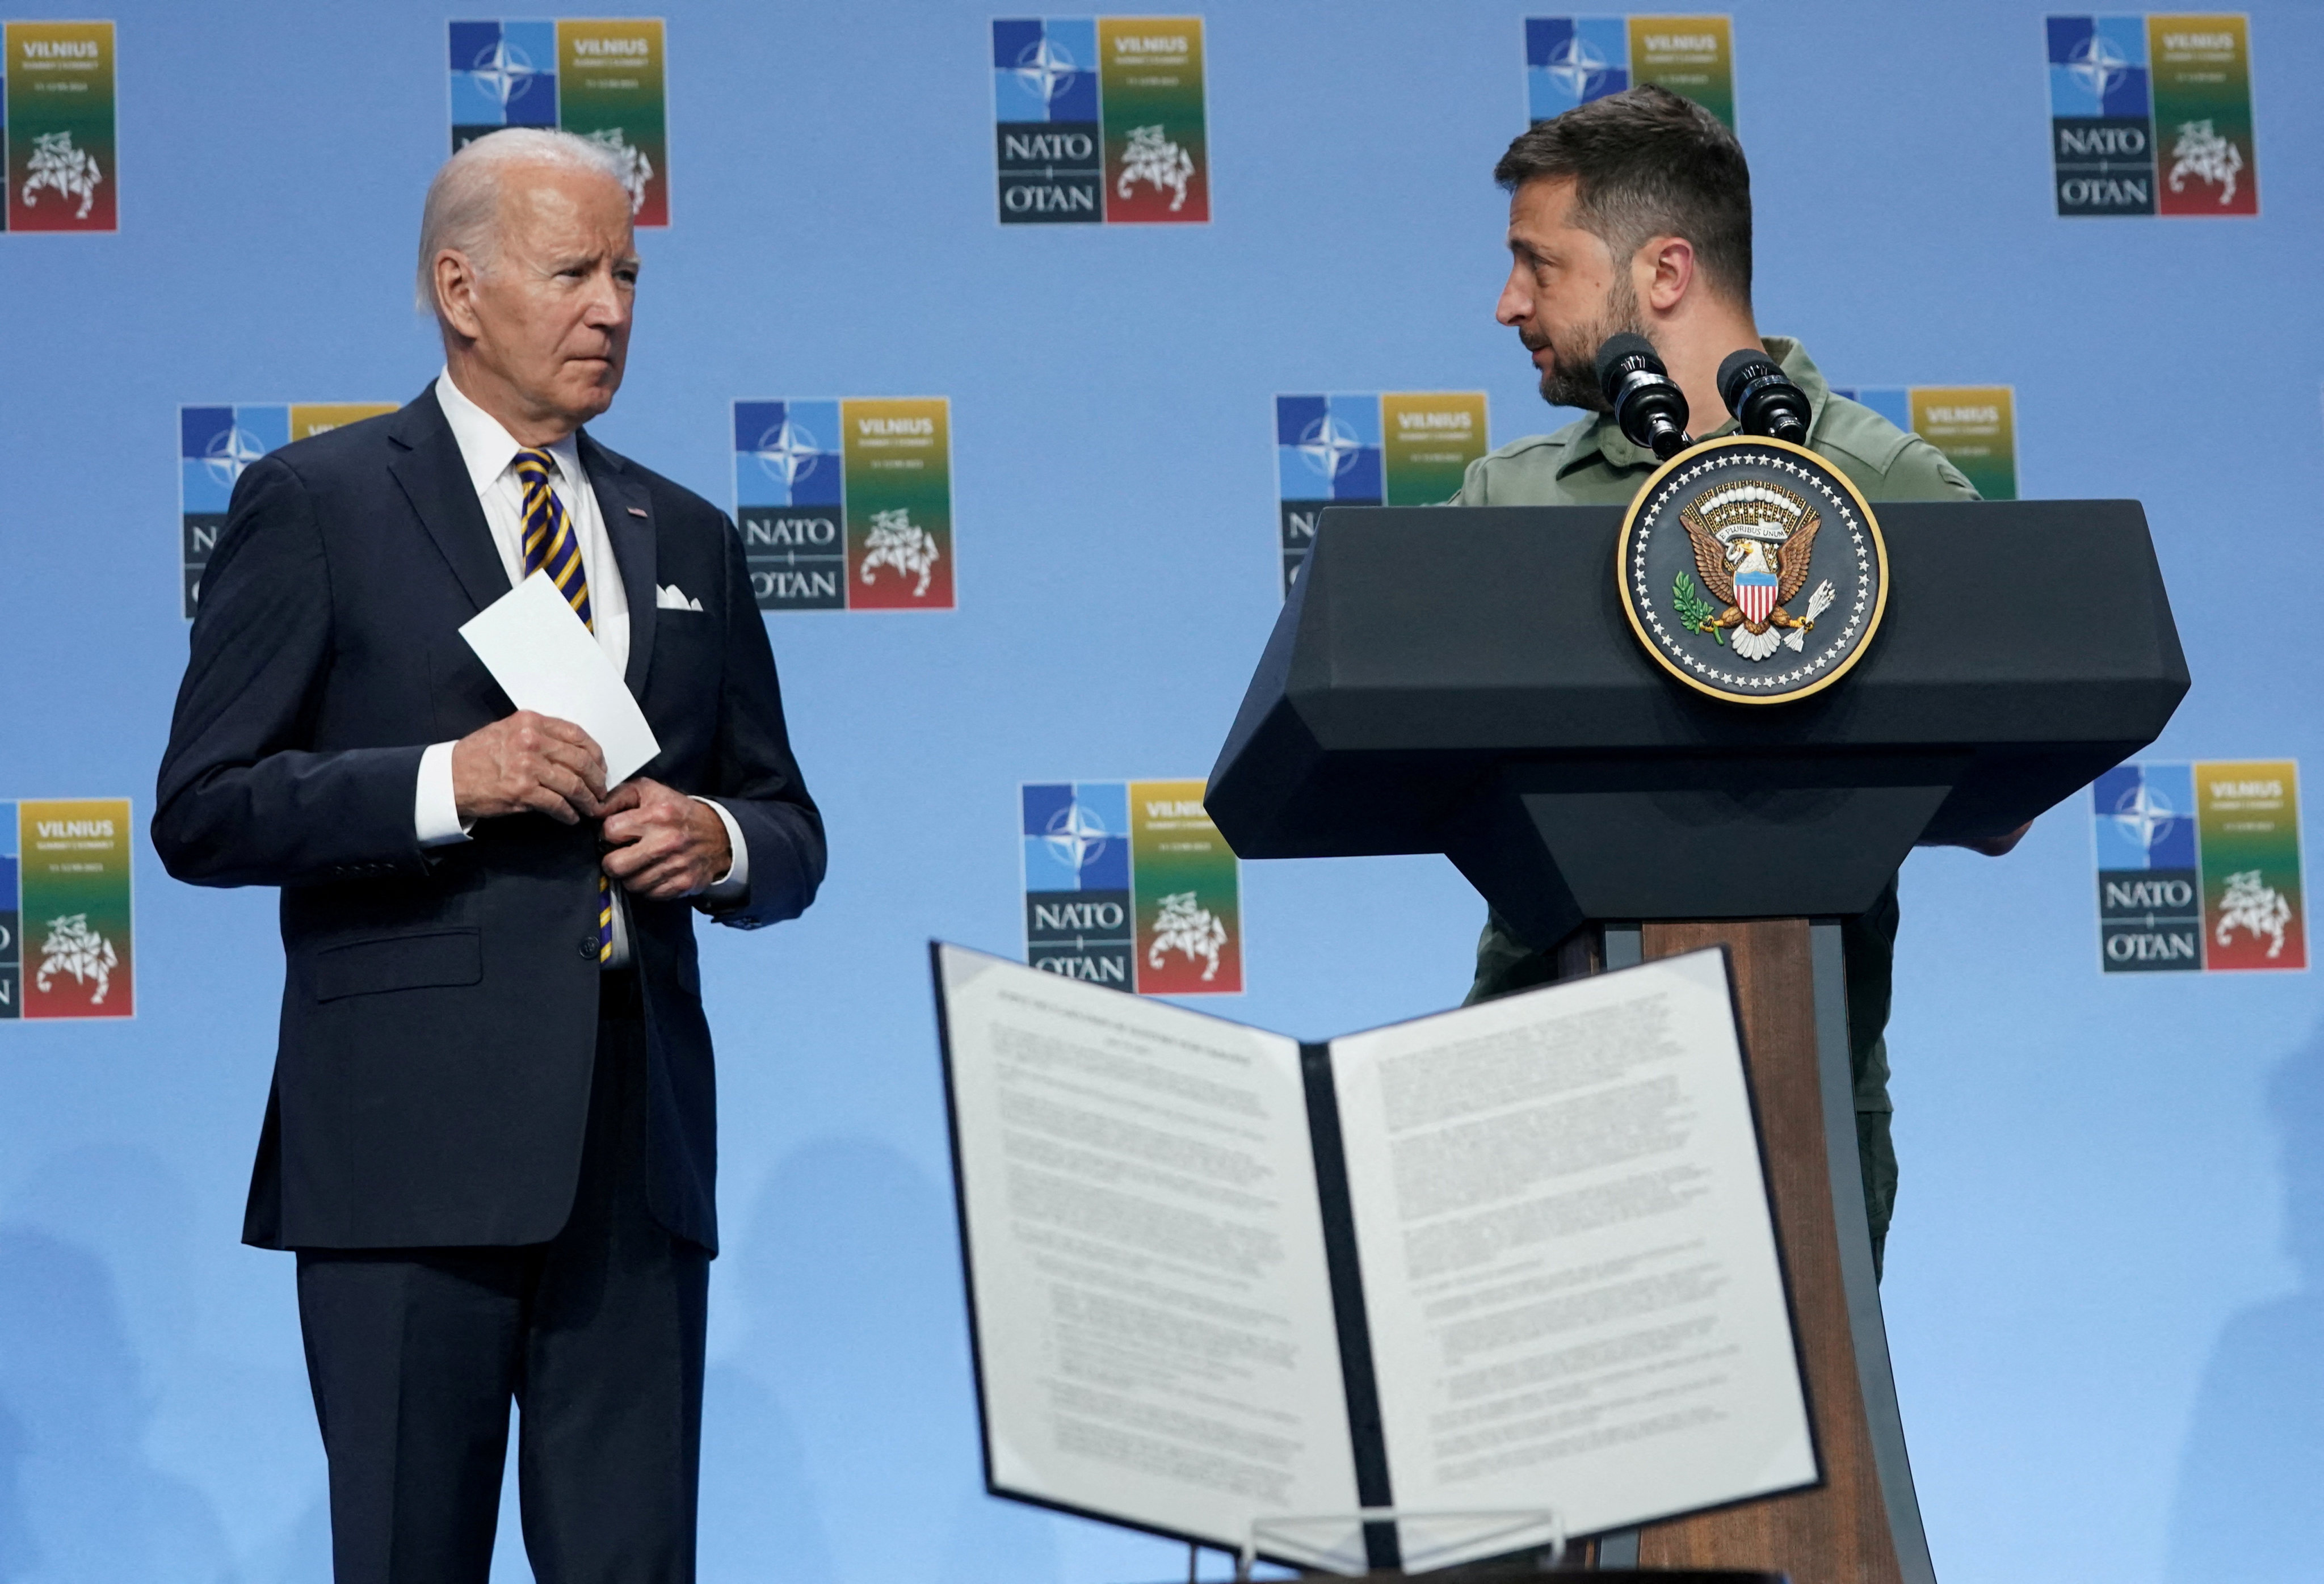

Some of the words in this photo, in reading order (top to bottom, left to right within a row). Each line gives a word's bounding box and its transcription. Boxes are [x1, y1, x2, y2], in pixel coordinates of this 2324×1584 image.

[23, 41, 98, 57] VILNIUS
[574, 39, 648, 55] VILNIUS
[1115, 36, 1187, 53] VILNIUS
[1645, 35, 1716, 51] VILNIUS
[2163, 33, 2234, 49] VILNIUS
[1006, 135, 1092, 159] NATO
[2061, 129, 2145, 154] NATO
[1006, 186, 1093, 211] OTAN
[2062, 179, 2147, 204] OTAN
[1398, 412, 1471, 428] VILNIUS
[1927, 406, 1998, 423] VILNIUS
[859, 418, 933, 434] VILNIUS
[747, 519, 835, 544] NATO
[1725, 526, 1761, 535] PLURIBUS
[752, 572, 836, 598] OTAN
[2211, 780, 2282, 798] VILNIUS
[1146, 800, 1208, 817] VILNIU
[37, 820, 114, 837] VILNIUS
[2107, 881, 2192, 907] NATO
[1036, 904, 1123, 930] NATO
[2107, 934, 2194, 960] OTAN
